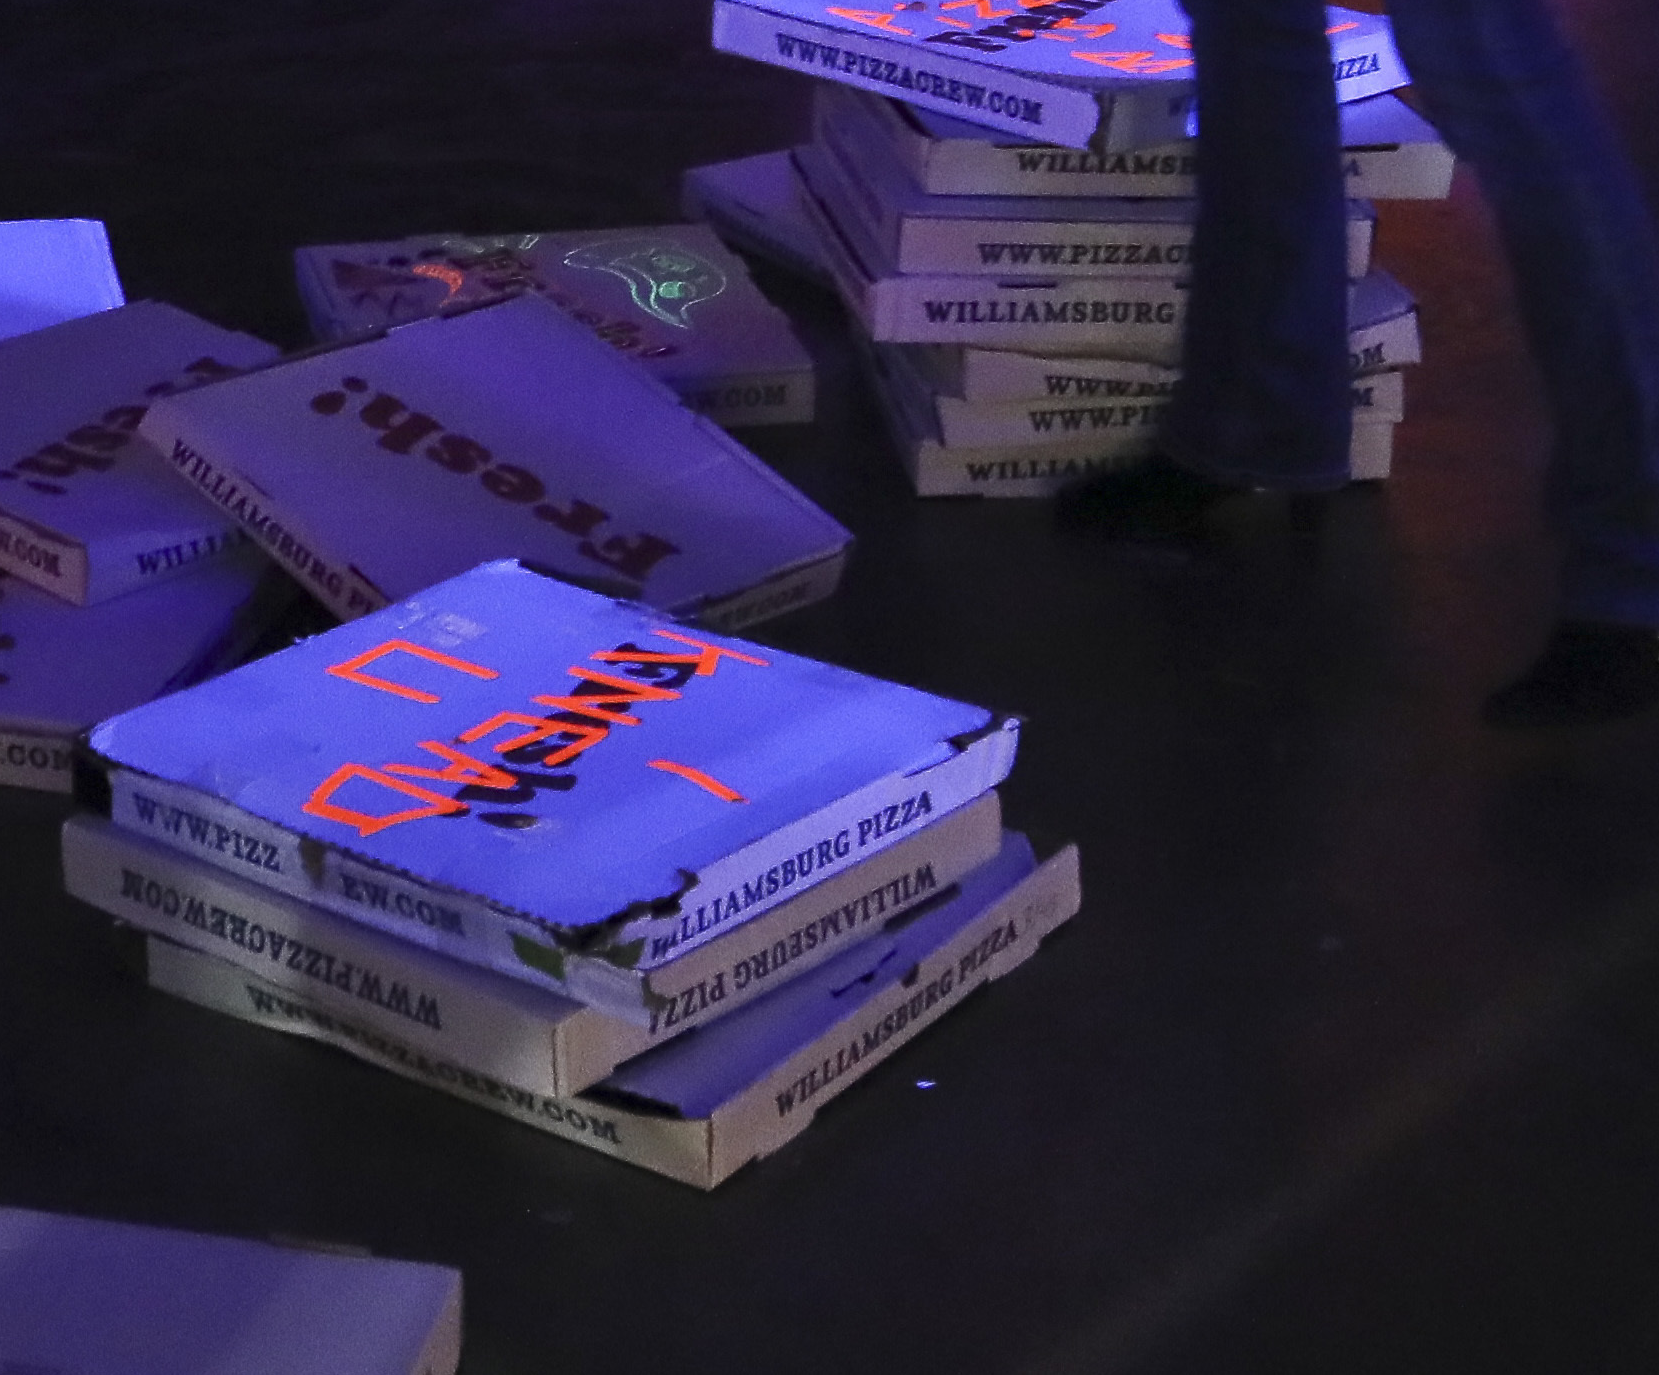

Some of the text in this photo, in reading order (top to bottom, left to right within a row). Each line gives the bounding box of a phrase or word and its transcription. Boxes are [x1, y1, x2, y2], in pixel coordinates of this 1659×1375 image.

[775, 31, 1044, 125] WWW.PIZZACREW.COM
[1331, 52, 1382, 82] IZZA
[923, 301, 1175, 325] WILLIAMSBURG
[171, 437, 346, 599] WILLIAMSBURG
[310, 375, 681, 582] Fresh!
[857, 790, 933, 850] PIZZA
[121, 866, 442, 1031] WWW.PIZZACREW.COM
[733, 861, 938, 990] WILLIAMSBURG
[776, 919, 1019, 1117] WILLIAMSBURG PIZZA
